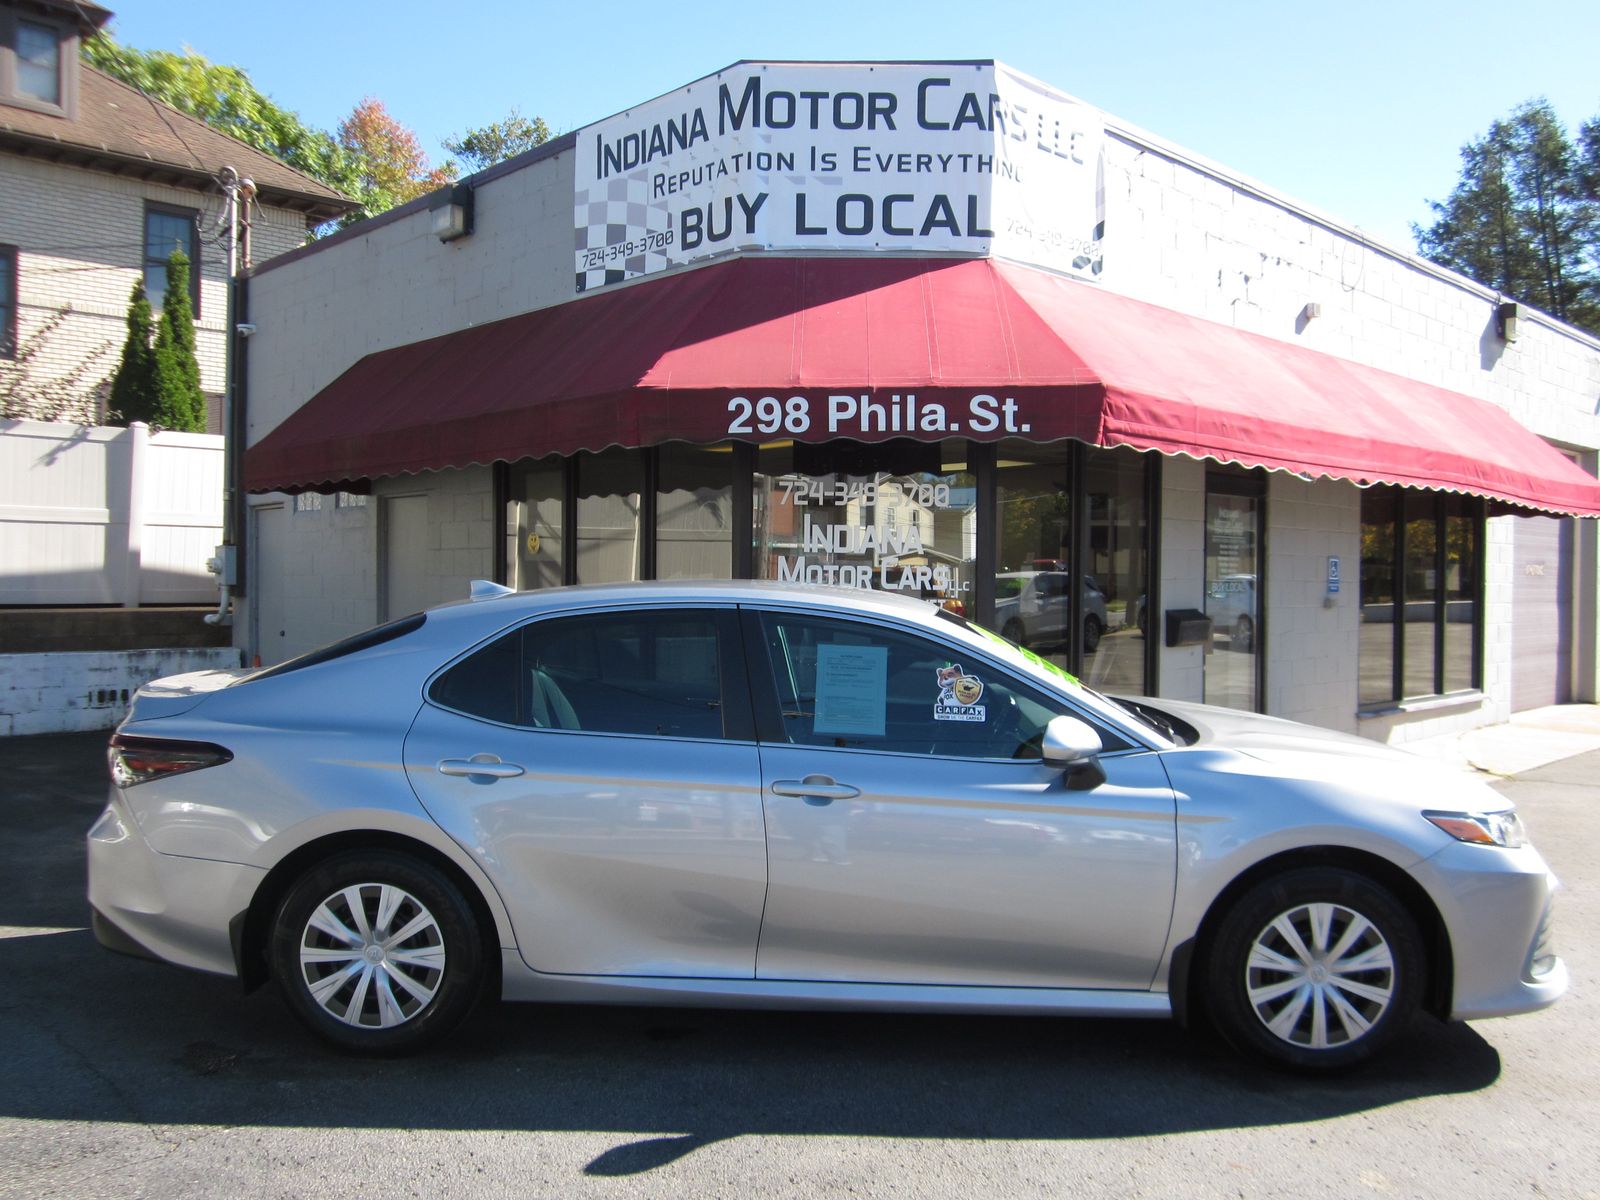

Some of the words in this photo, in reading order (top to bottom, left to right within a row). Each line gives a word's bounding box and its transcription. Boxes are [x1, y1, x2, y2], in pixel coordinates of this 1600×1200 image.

[596, 107, 710, 180] INDIANA
[718, 76, 898, 137] MOTOR
[917, 77, 1028, 142] CARS
[1037, 114, 1085, 165] LLC
[653, 151, 795, 199] REPUTATION
[810, 145, 838, 172] IS
[680, 192, 770, 252] BUY
[795, 192, 996, 238] LOCAL
[581, 229, 675, 269] 724-349-3700
[727, 396, 811, 434] 298
[828, 394, 960, 433] Phila.
[968, 394, 1032, 433] St.
[803, 513, 925, 555] INDIANA
[777, 555, 874, 590] MOTOR
[880, 557, 949, 591] CARS
[936, 705, 984, 716] CARFAX
